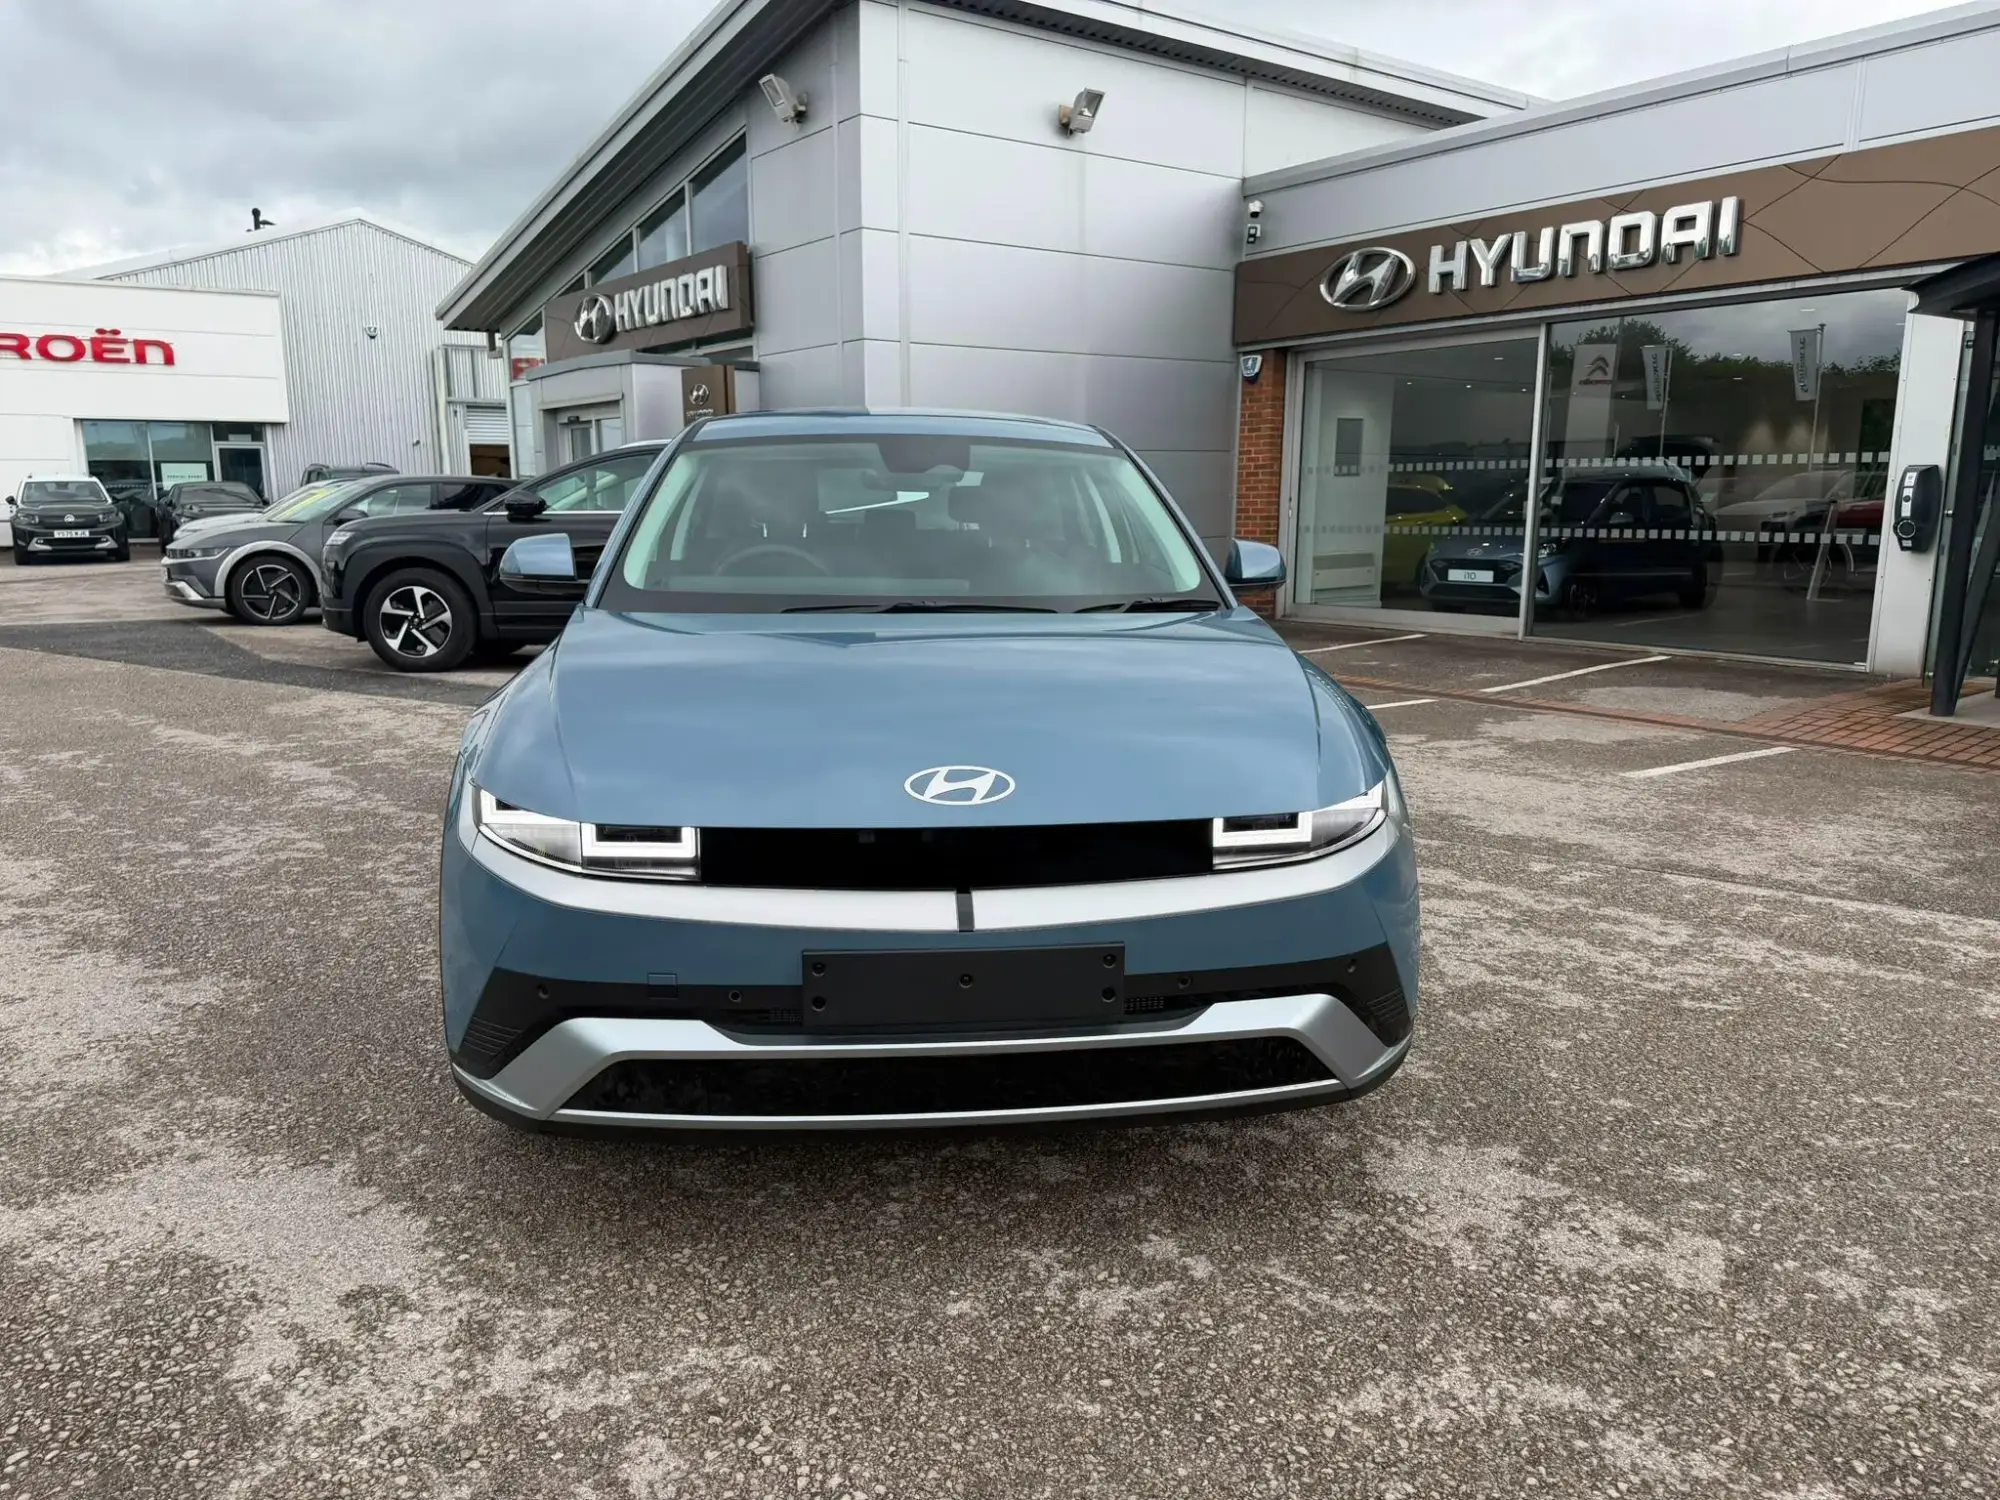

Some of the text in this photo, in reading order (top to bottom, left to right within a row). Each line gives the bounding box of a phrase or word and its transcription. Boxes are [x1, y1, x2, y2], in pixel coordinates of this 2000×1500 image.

[1428, 196, 1738, 293] HYUNDAI
[614, 265, 729, 332] HYUNDAI
[1463, 571, 1477, 581] i10
